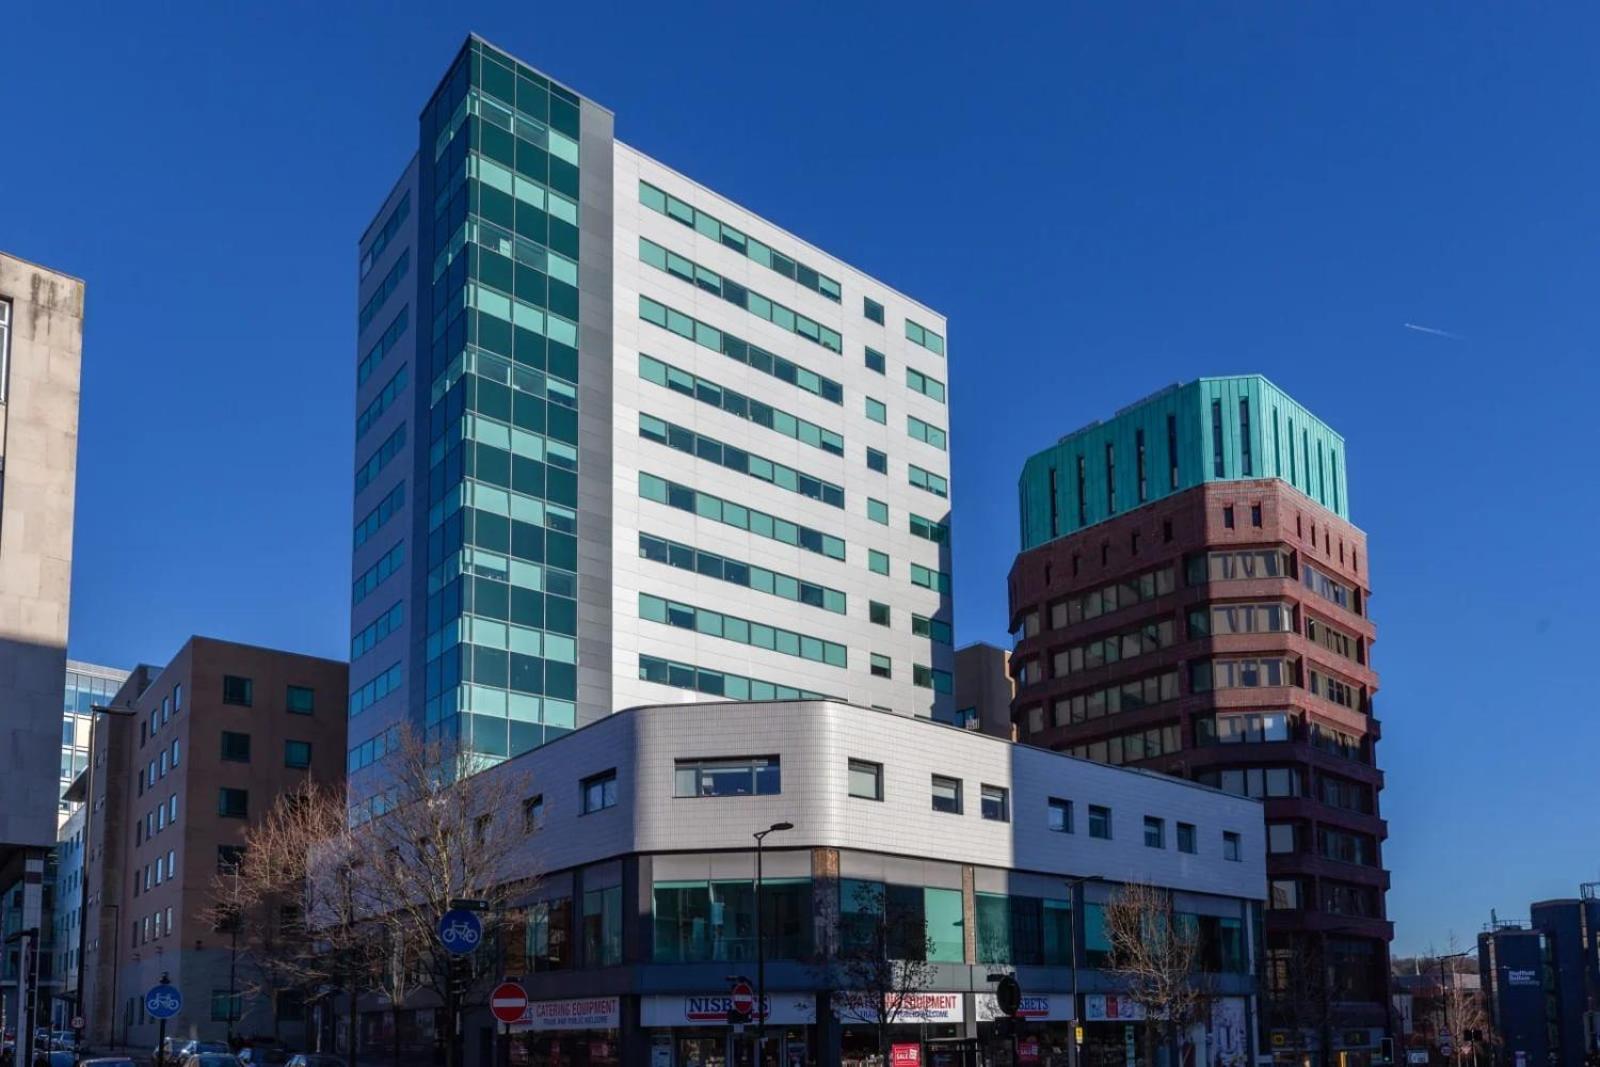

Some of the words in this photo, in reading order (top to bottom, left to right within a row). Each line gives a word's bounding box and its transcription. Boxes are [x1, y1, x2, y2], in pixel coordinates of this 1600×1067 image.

[536, 1002, 571, 1017] CATERING
[572, 998, 616, 1016] EQUIPMENT
[688, 998, 768, 1012] NISBS
